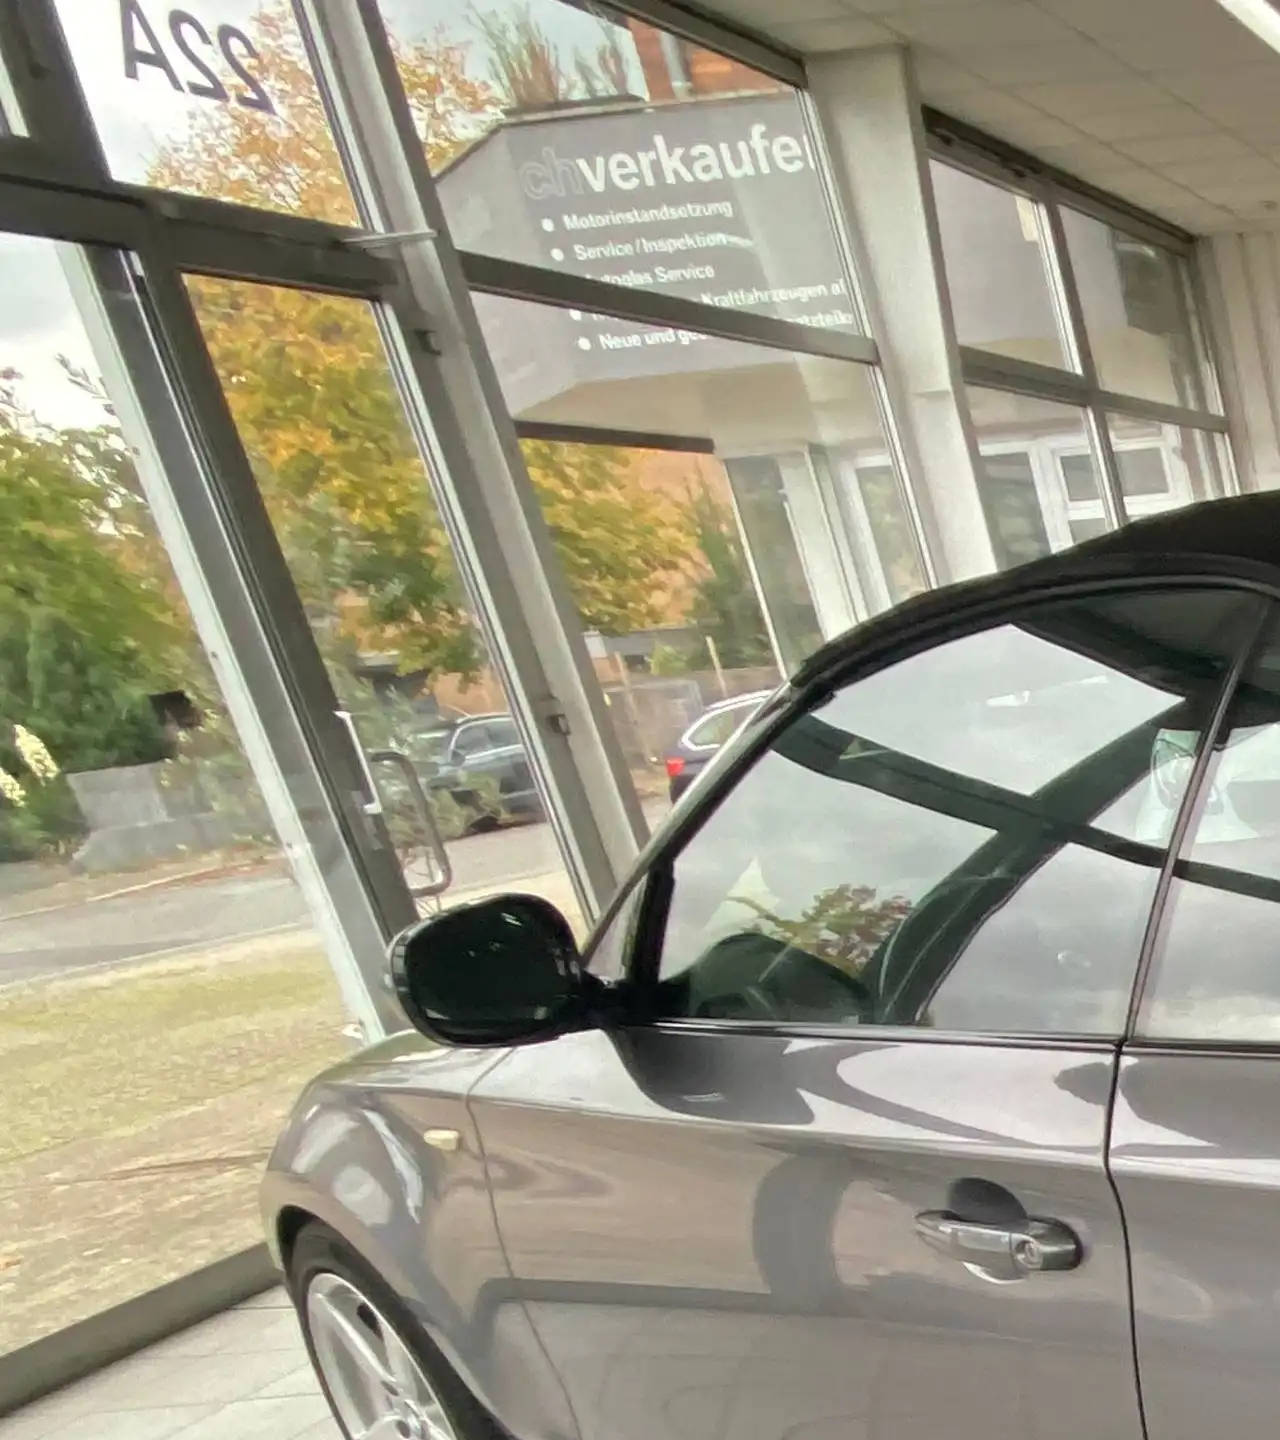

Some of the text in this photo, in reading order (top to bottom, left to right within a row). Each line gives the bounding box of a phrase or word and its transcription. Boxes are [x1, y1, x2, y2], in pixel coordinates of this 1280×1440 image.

[563, 202, 734, 230] Motorinstandsetzung
[655, 263, 715, 283] Service
[599, 334, 641, 349] Neue
[643, 327, 676, 345] und
